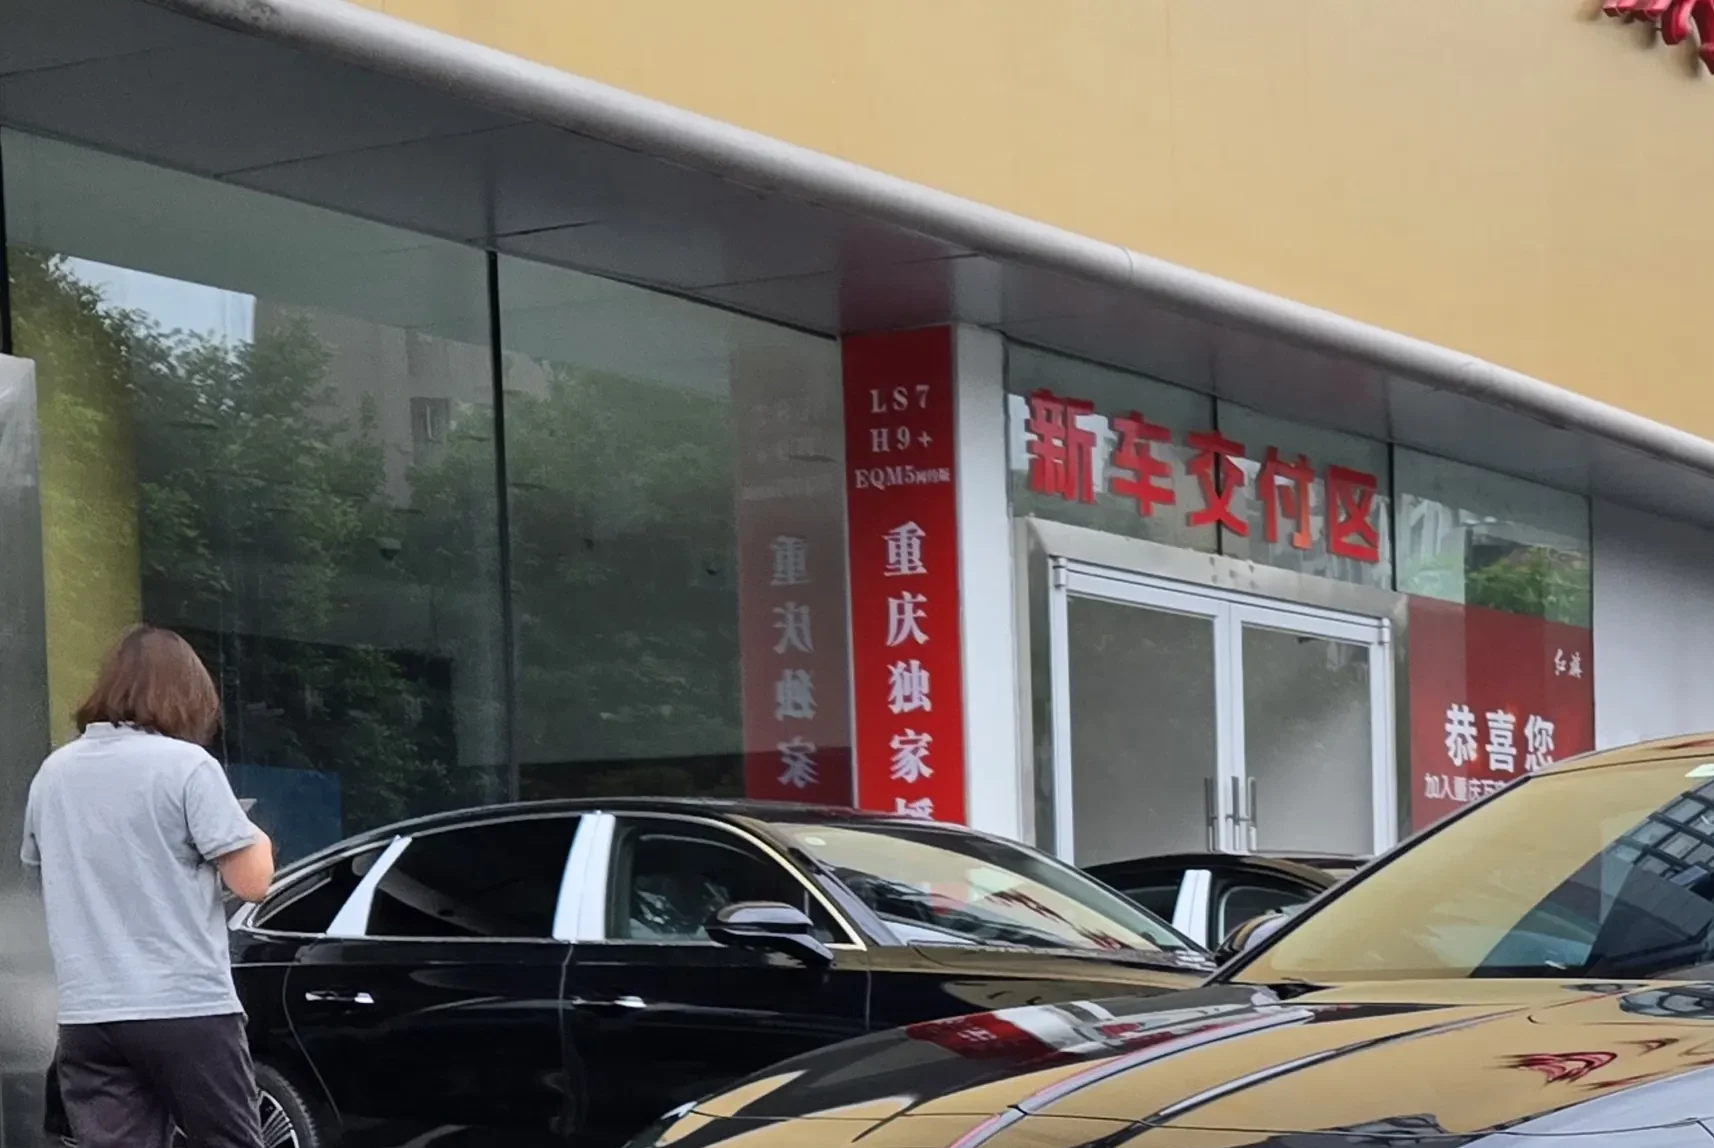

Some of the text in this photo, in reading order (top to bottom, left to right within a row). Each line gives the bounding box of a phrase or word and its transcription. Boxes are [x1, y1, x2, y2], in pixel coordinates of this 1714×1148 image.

[870, 425, 933, 453] H9+
[1026, 388, 1380, 564] 新车交付区
[1444, 703, 1555, 773] 恭喜您
